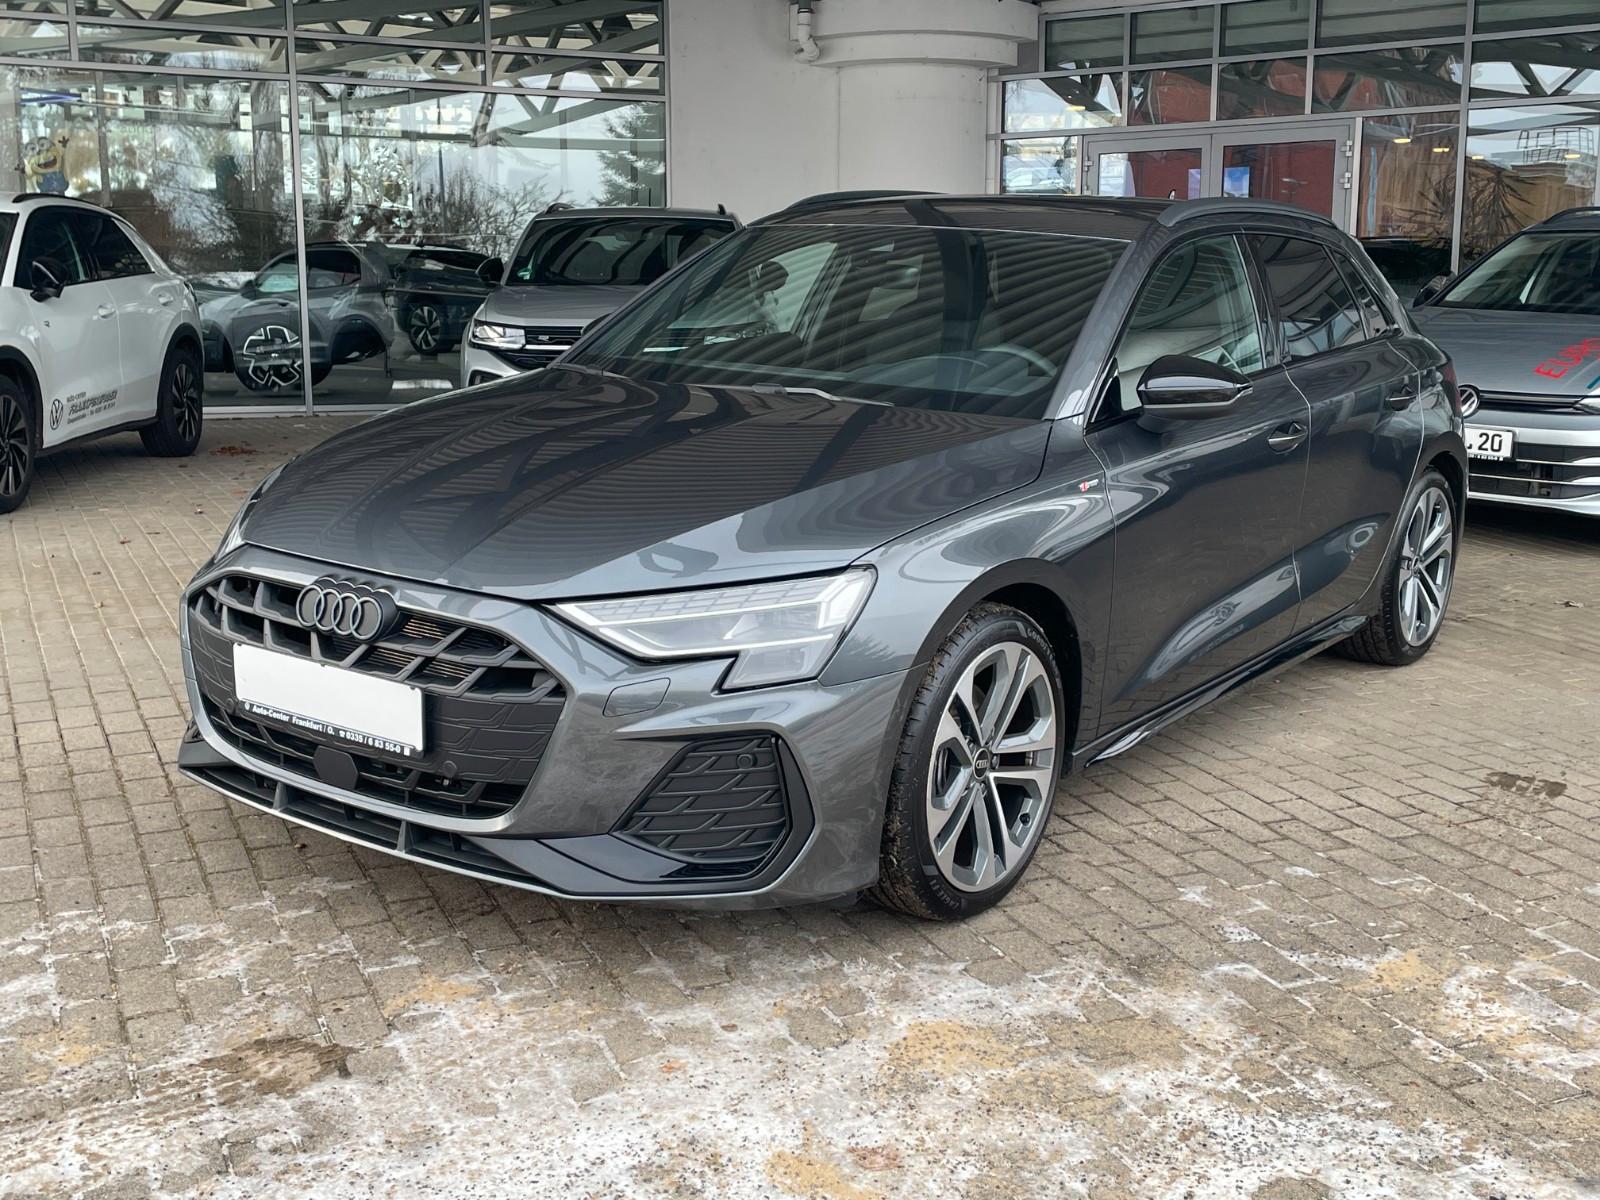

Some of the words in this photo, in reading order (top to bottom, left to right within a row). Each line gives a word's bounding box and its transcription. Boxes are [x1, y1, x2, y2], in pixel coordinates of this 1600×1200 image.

[1478, 432, 1503, 452] 20
[252, 705, 289, 721] Auto-Center
[292, 715, 323, 731] Frankfurt
